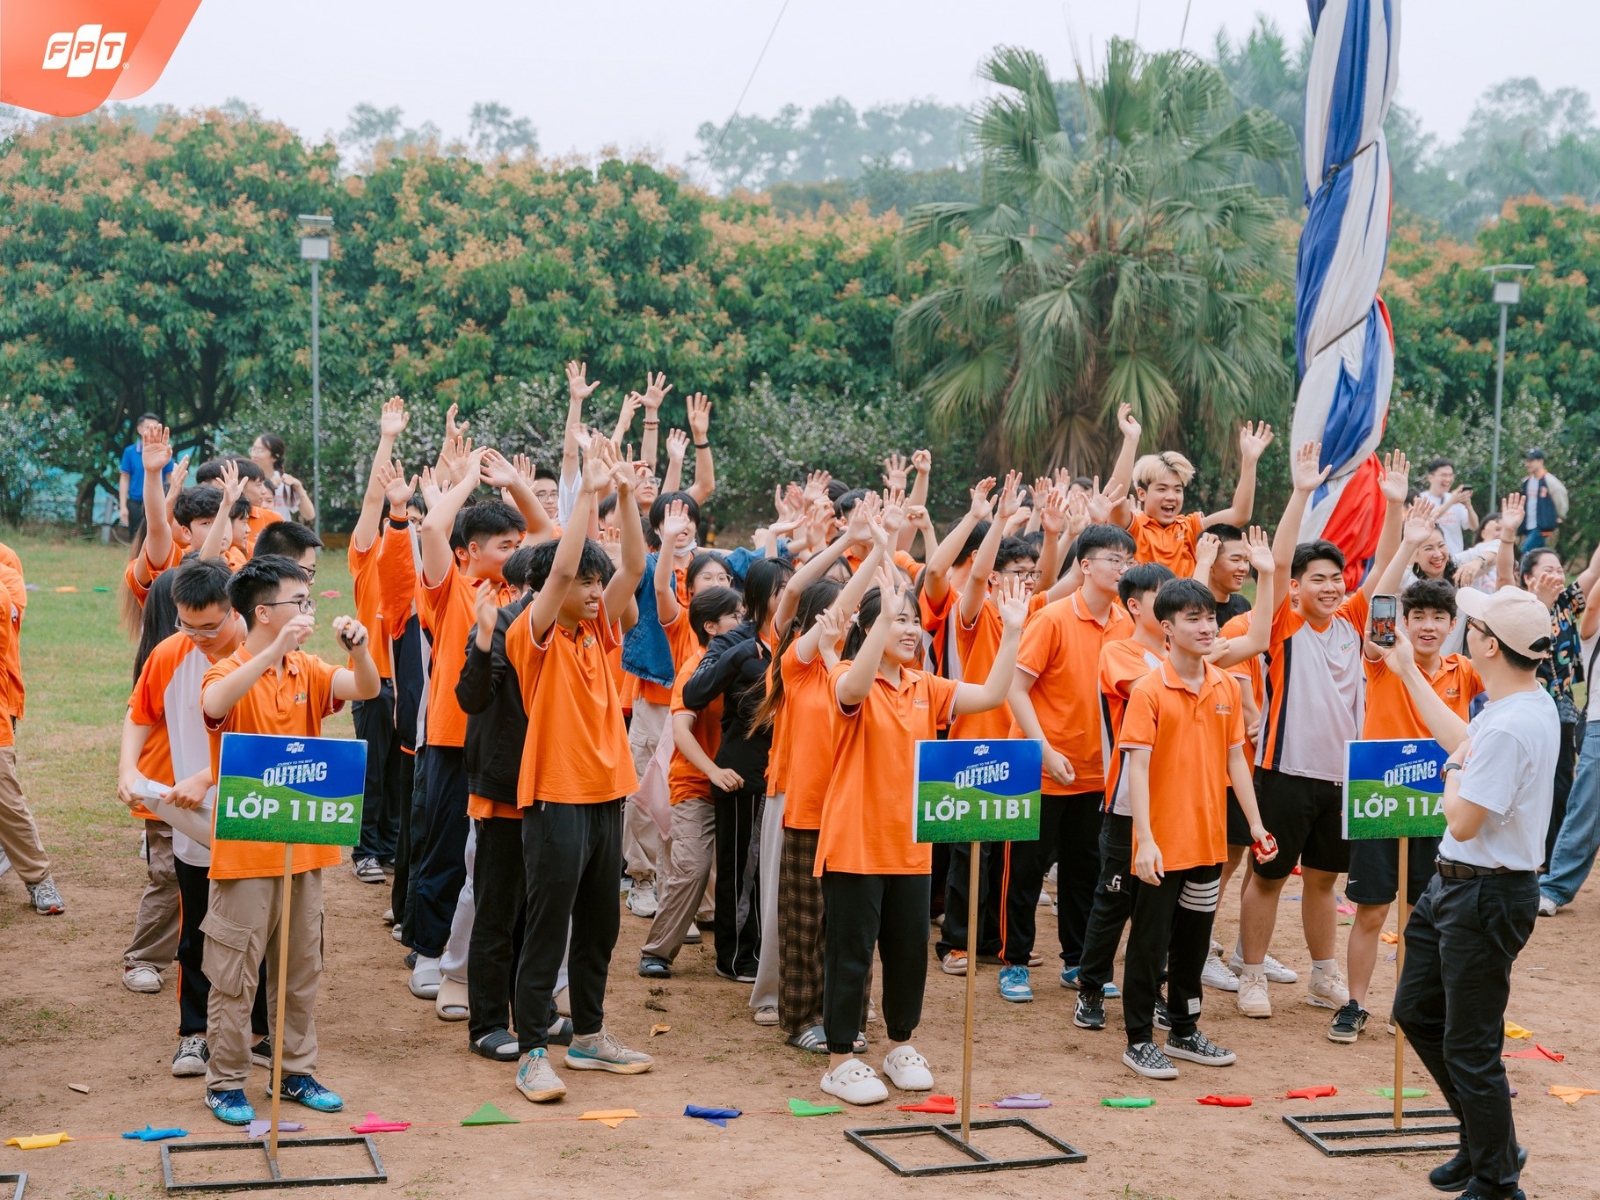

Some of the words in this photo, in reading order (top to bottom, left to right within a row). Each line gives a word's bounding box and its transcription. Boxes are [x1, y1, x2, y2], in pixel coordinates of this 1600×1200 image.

[262, 761, 328, 788] OUTING
[955, 761, 1010, 790] OUTING
[1384, 760, 1437, 788] OUTING
[226, 791, 280, 819] LỚP
[290, 800, 354, 823] 11B2
[924, 794, 971, 821] LỚP
[979, 799, 1031, 820] 11B1
[1353, 792, 1399, 818] LỚP
